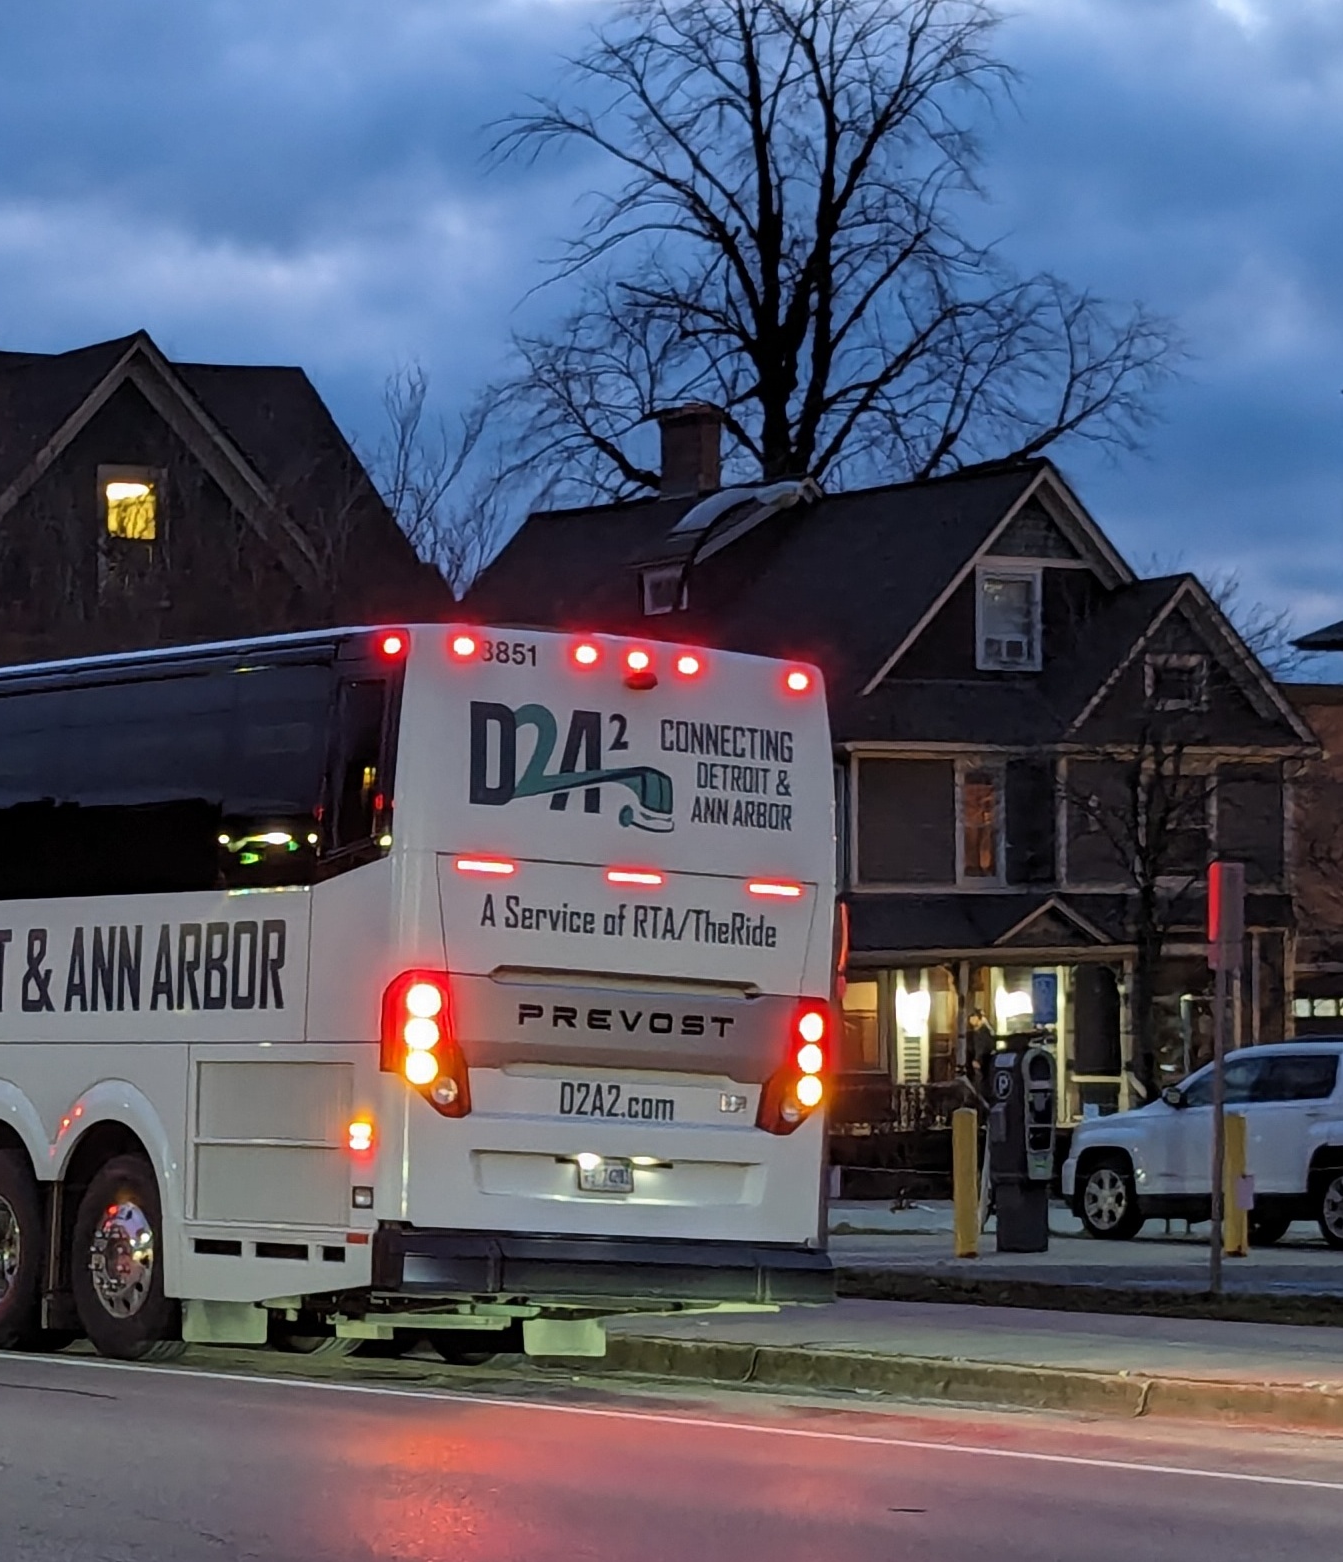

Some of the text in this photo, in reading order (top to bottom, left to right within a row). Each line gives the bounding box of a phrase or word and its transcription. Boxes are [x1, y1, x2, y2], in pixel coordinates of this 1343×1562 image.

[660, 718, 794, 764] CONNECTING
[696, 762, 792, 797] DETROIT &
[690, 796, 793, 832] ANN ARBOR
[481, 894, 777, 949] A Service of RTA/TheRide
[21, 927, 55, 1014] &
[64, 924, 143, 1013] ANN
[149, 918, 288, 1012] ARBOR
[517, 1004, 735, 1038] PREVOST
[559, 1081, 675, 1122] D2A2.com
